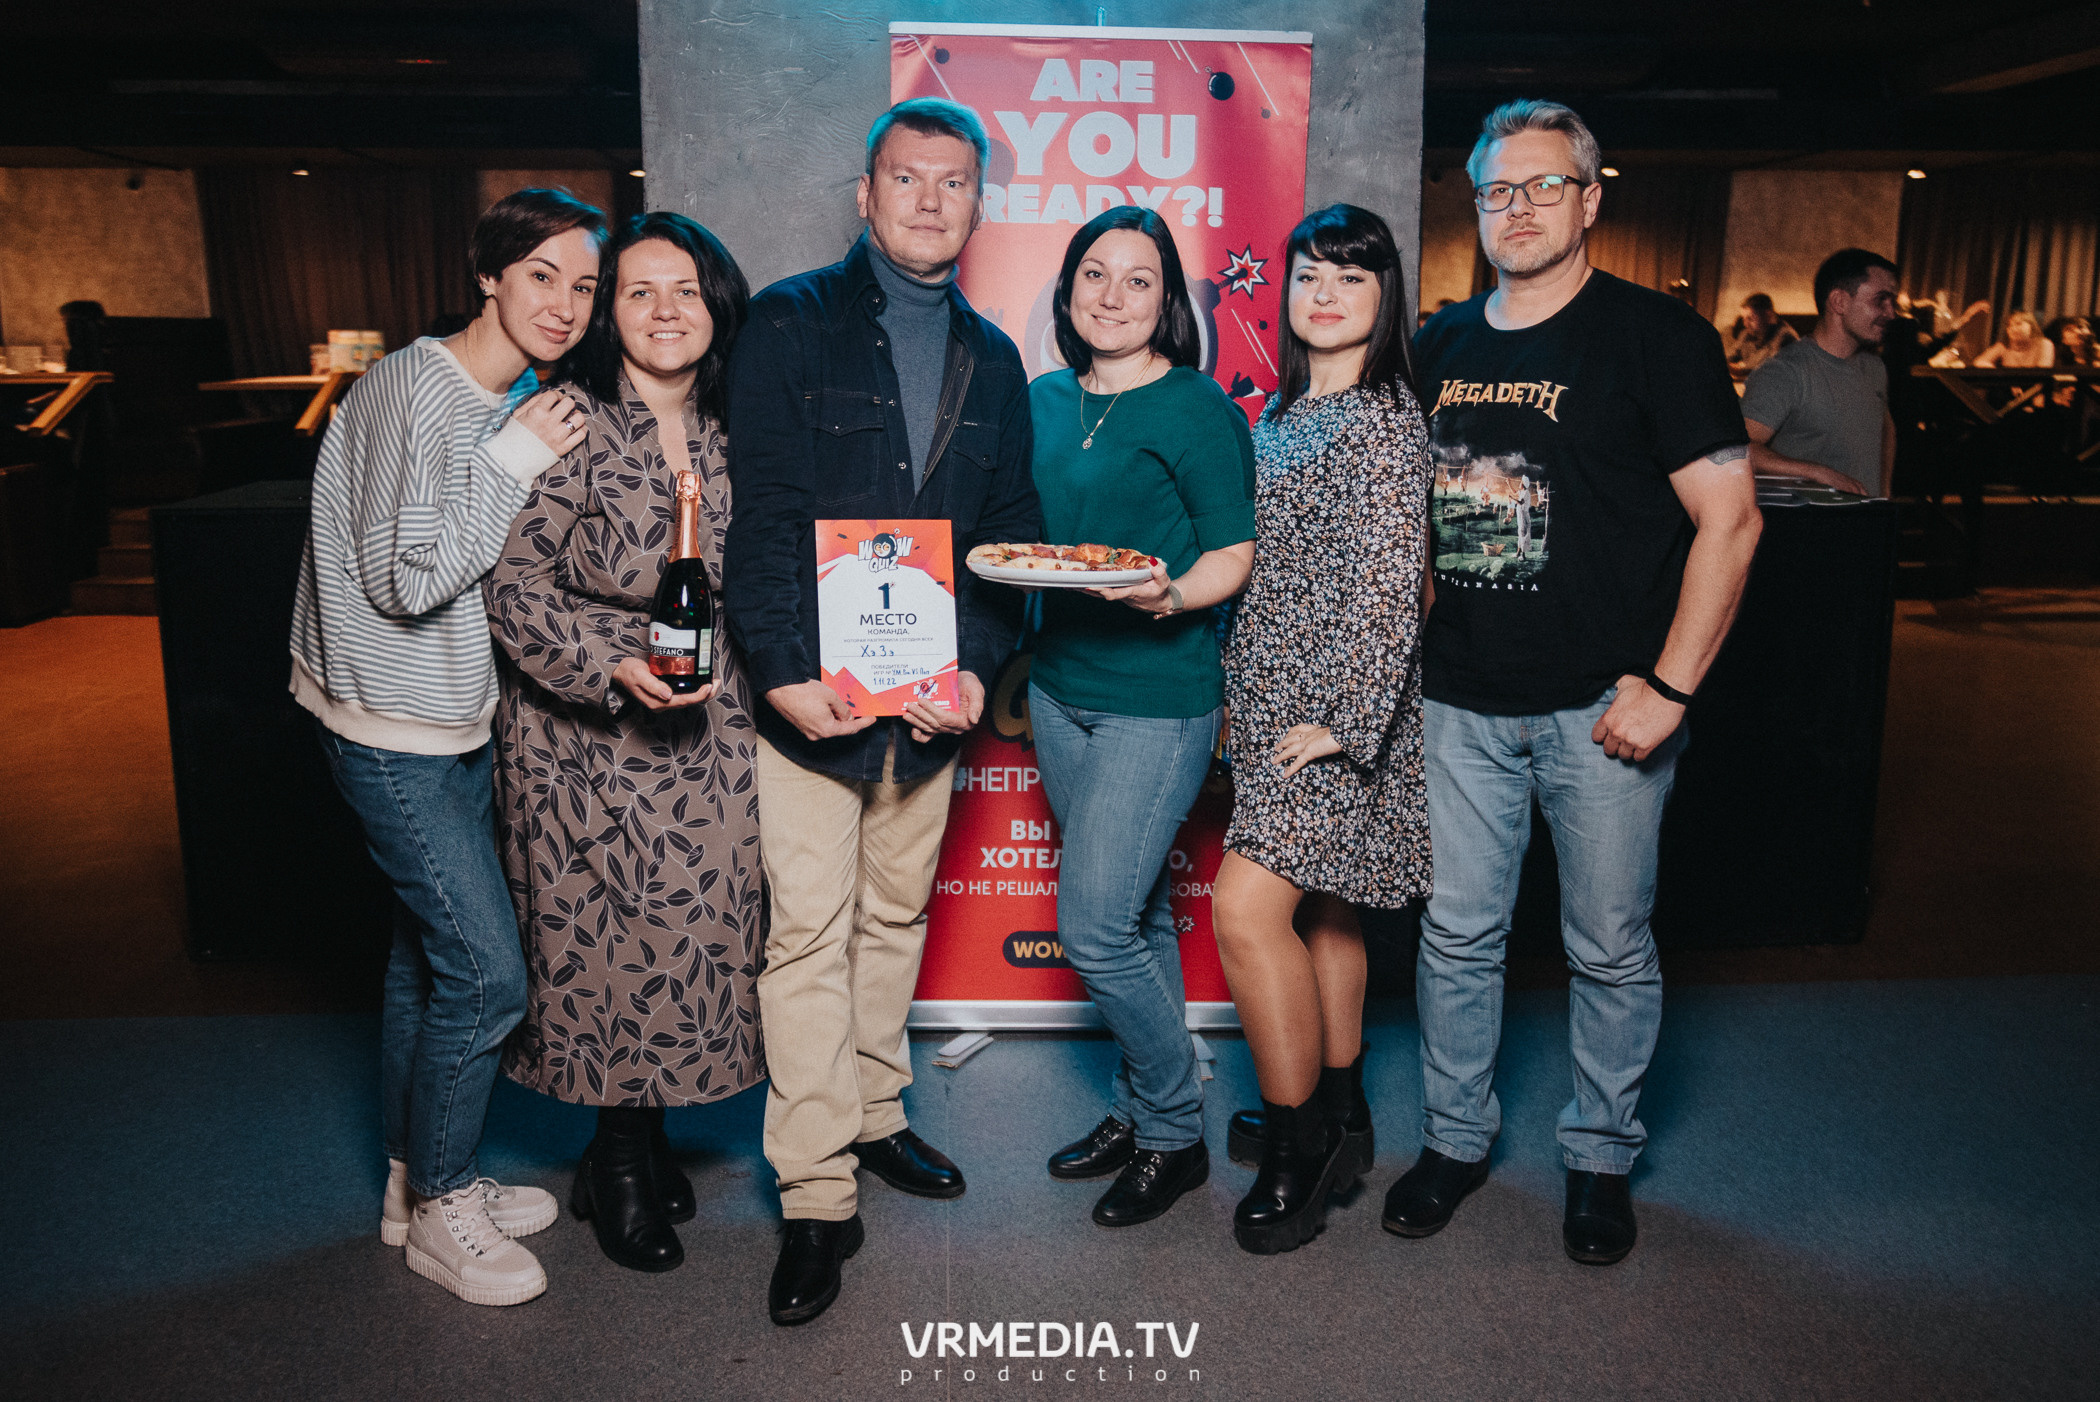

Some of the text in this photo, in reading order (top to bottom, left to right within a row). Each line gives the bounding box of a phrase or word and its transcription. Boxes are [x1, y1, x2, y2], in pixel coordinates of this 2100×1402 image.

[1030, 58, 1155, 104] ARE
[993, 110, 1199, 180] YOU
[1429, 379, 1569, 422] MEGADETH
[869, 556, 899, 573] QUIZ
[878, 582, 891, 610] 1
[860, 613, 917, 626] МЕСТО
[653, 646, 684, 656] STEFANO
[952, 767, 1041, 792] #НЕПР
[1011, 820, 1050, 841] ВЫ
[980, 847, 1063, 869] ХОТЕЛ
[936, 880, 1058, 896] НО НЕ РЕШАЛ
[1012, 941, 1067, 959] WOW
